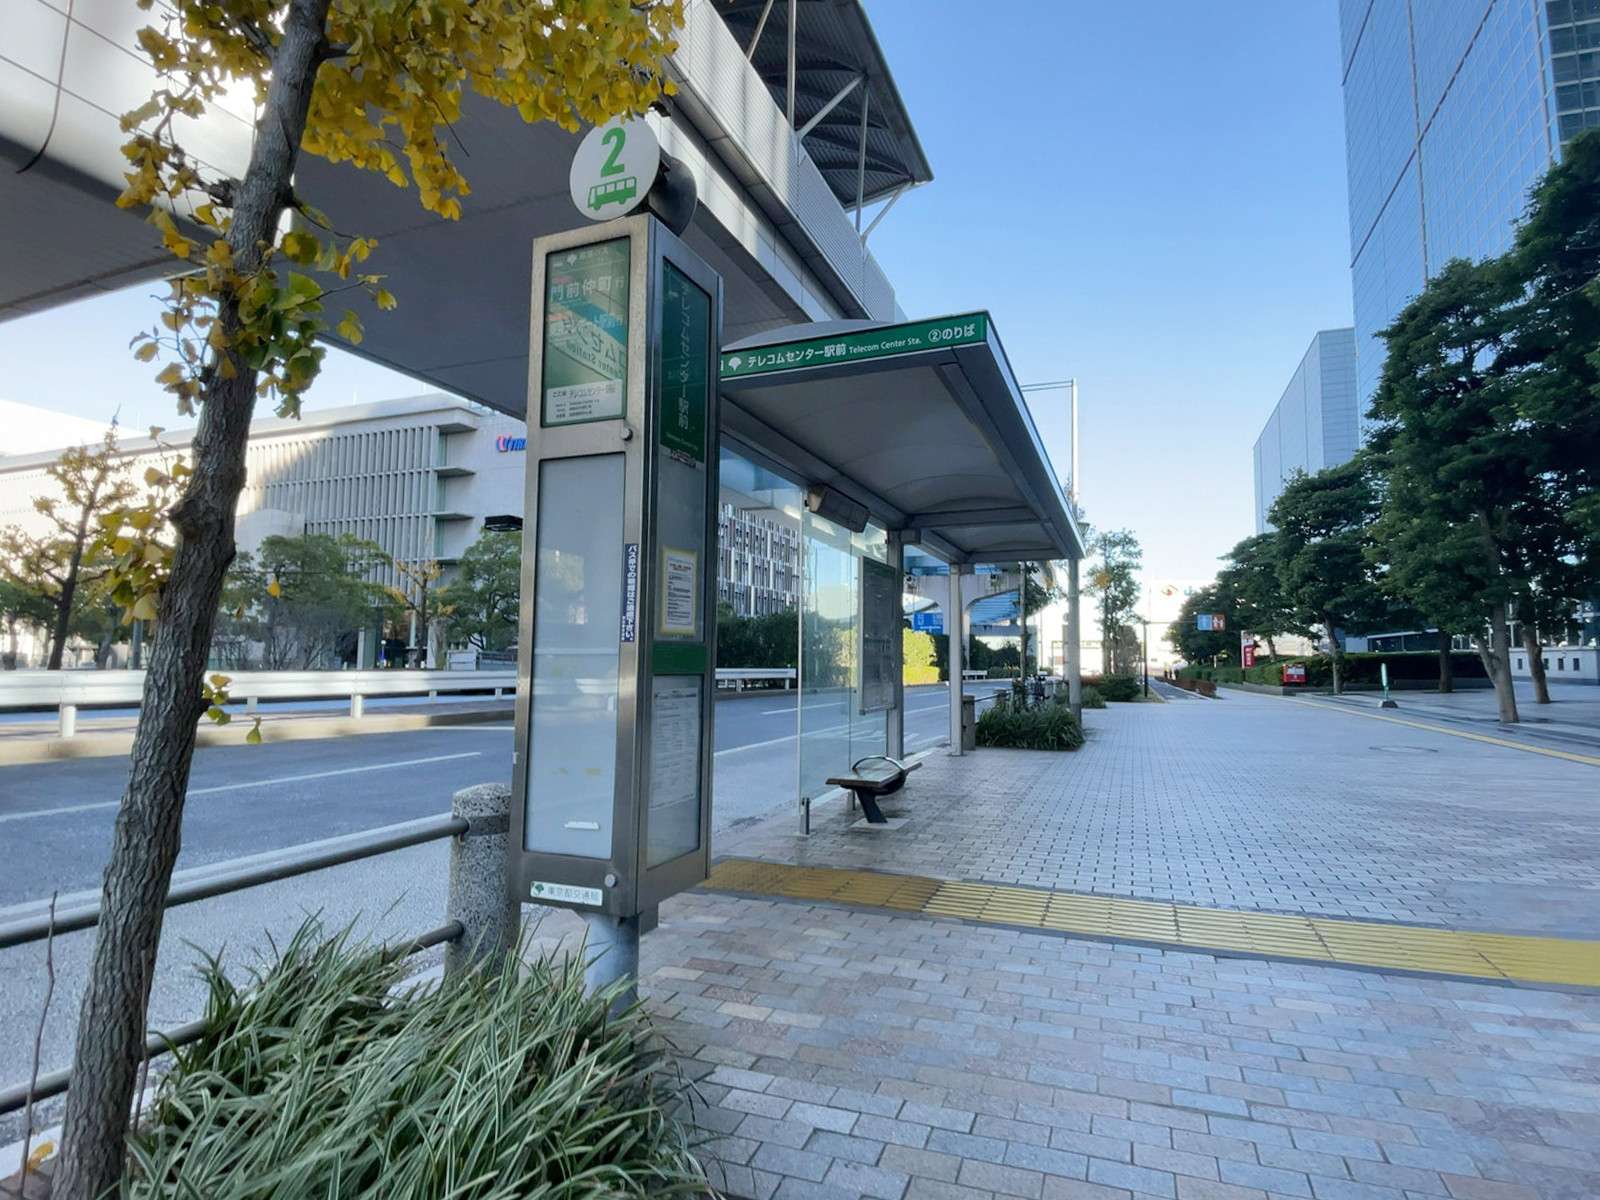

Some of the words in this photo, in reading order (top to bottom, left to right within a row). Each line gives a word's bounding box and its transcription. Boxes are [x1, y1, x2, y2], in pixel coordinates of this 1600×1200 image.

[601, 127, 626, 177] 2
[748, 343, 846, 368] テレコムセンター駅前
[849, 344, 879, 354] Telecom
[881, 340, 906, 350] Center
[907, 337, 922, 346] Sta.
